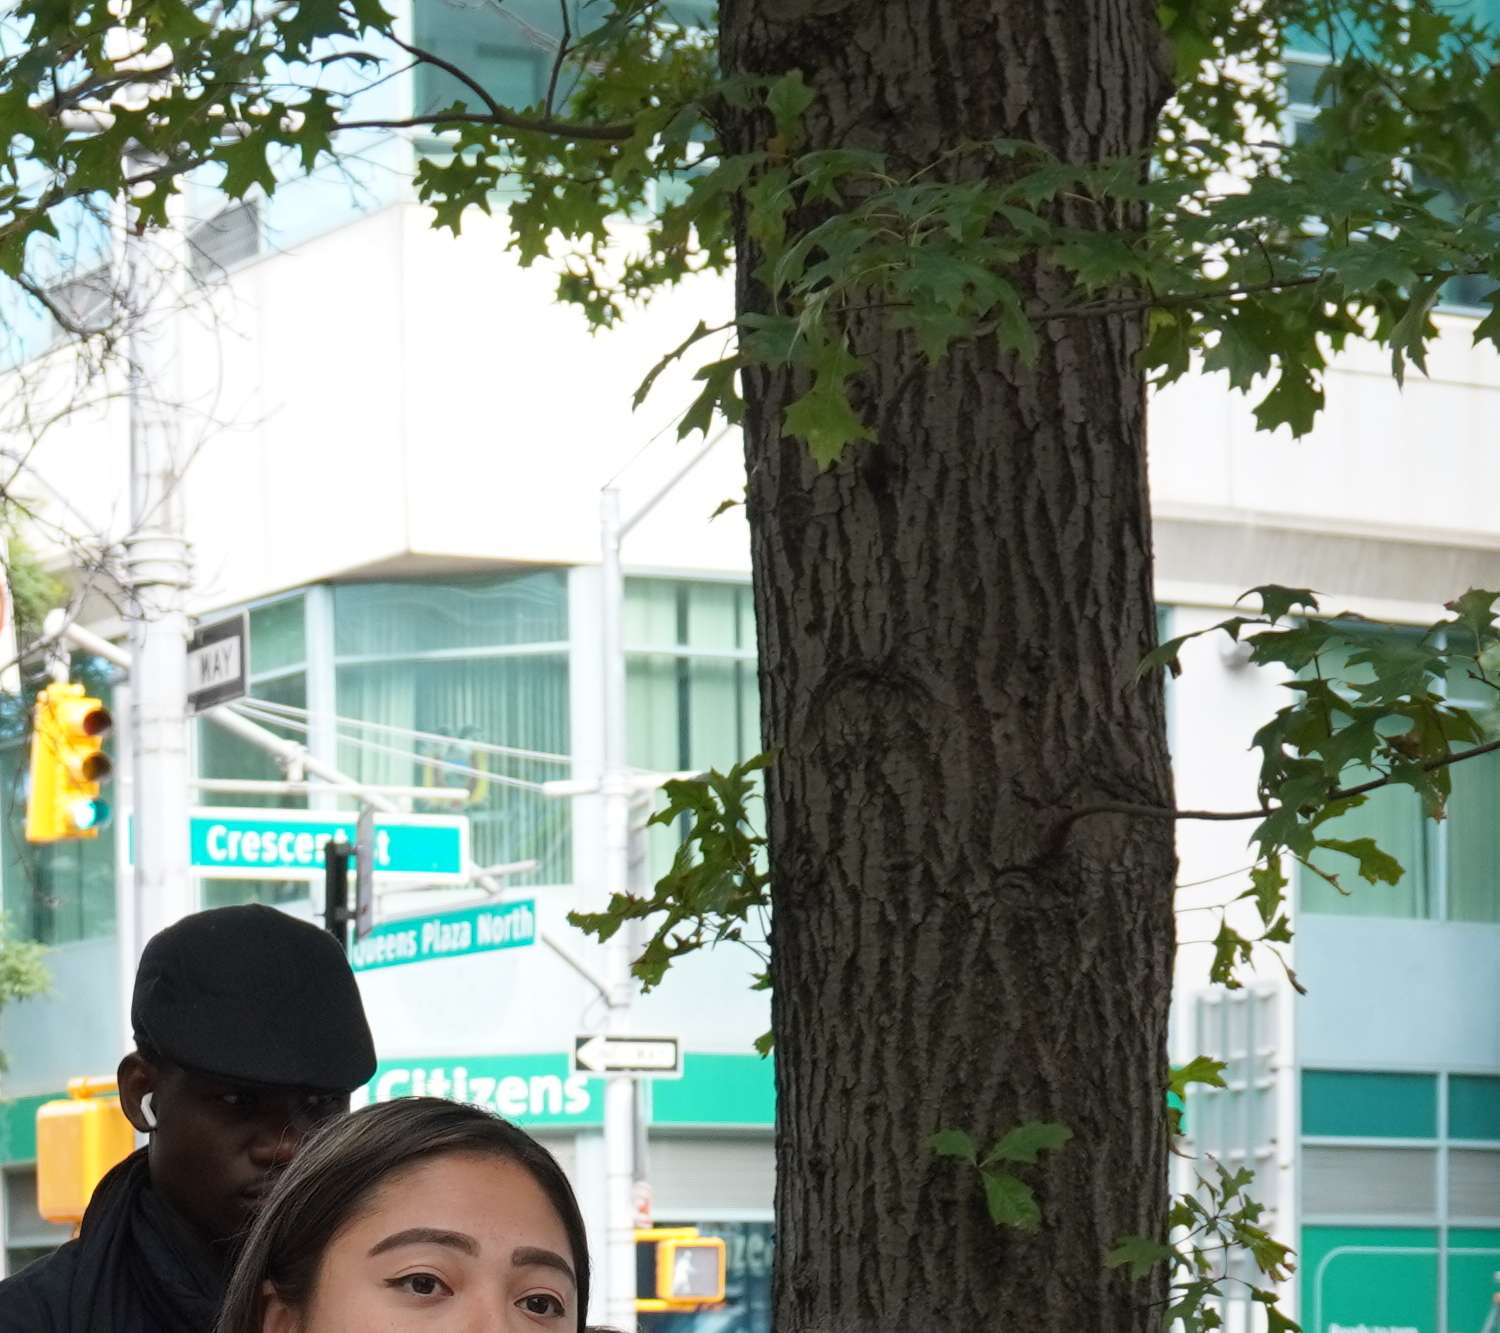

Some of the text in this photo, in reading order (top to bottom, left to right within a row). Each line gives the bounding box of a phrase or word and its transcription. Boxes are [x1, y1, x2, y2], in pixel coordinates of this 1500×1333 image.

[199, 644, 232, 683] WAY
[353, 906, 533, 967] Queens Plaza North
[376, 1067, 590, 1115] Citizens
